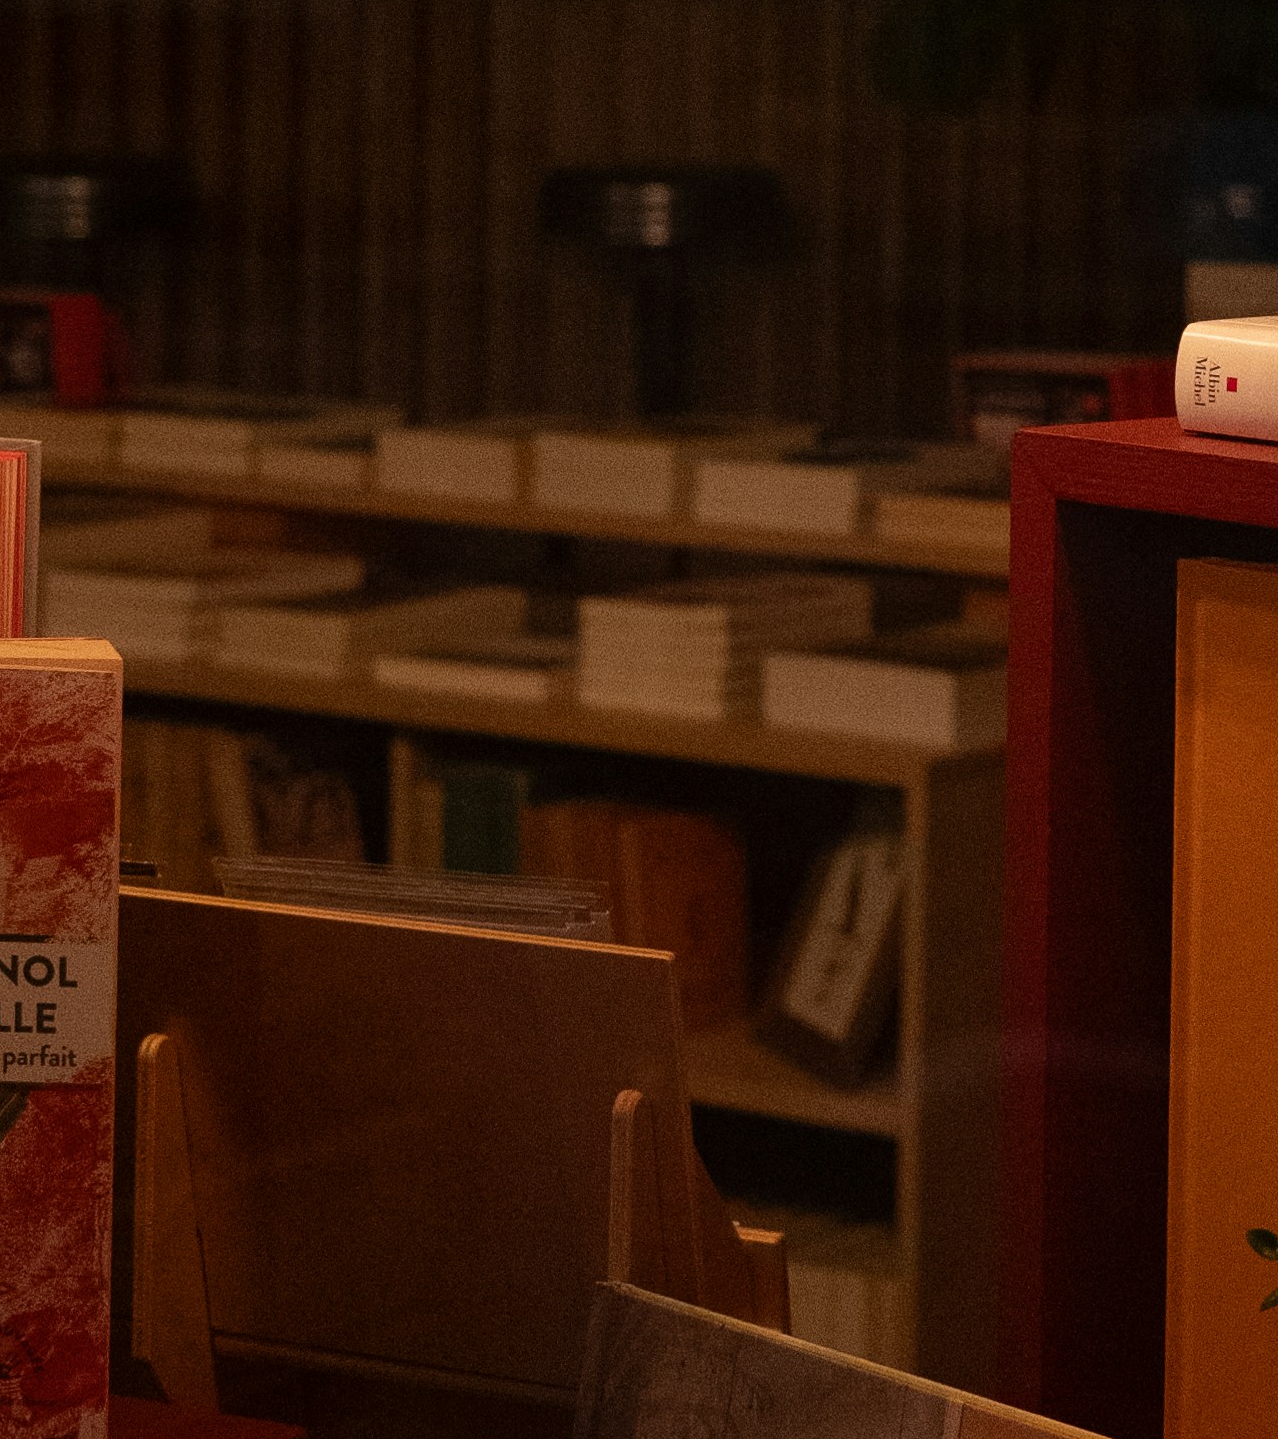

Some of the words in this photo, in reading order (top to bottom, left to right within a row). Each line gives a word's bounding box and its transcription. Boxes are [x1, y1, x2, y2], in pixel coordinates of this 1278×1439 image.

[1193, 355, 1208, 408] Michel
[1208, 360, 1220, 405] Albin
[2, 1042, 77, 1074] parfait
